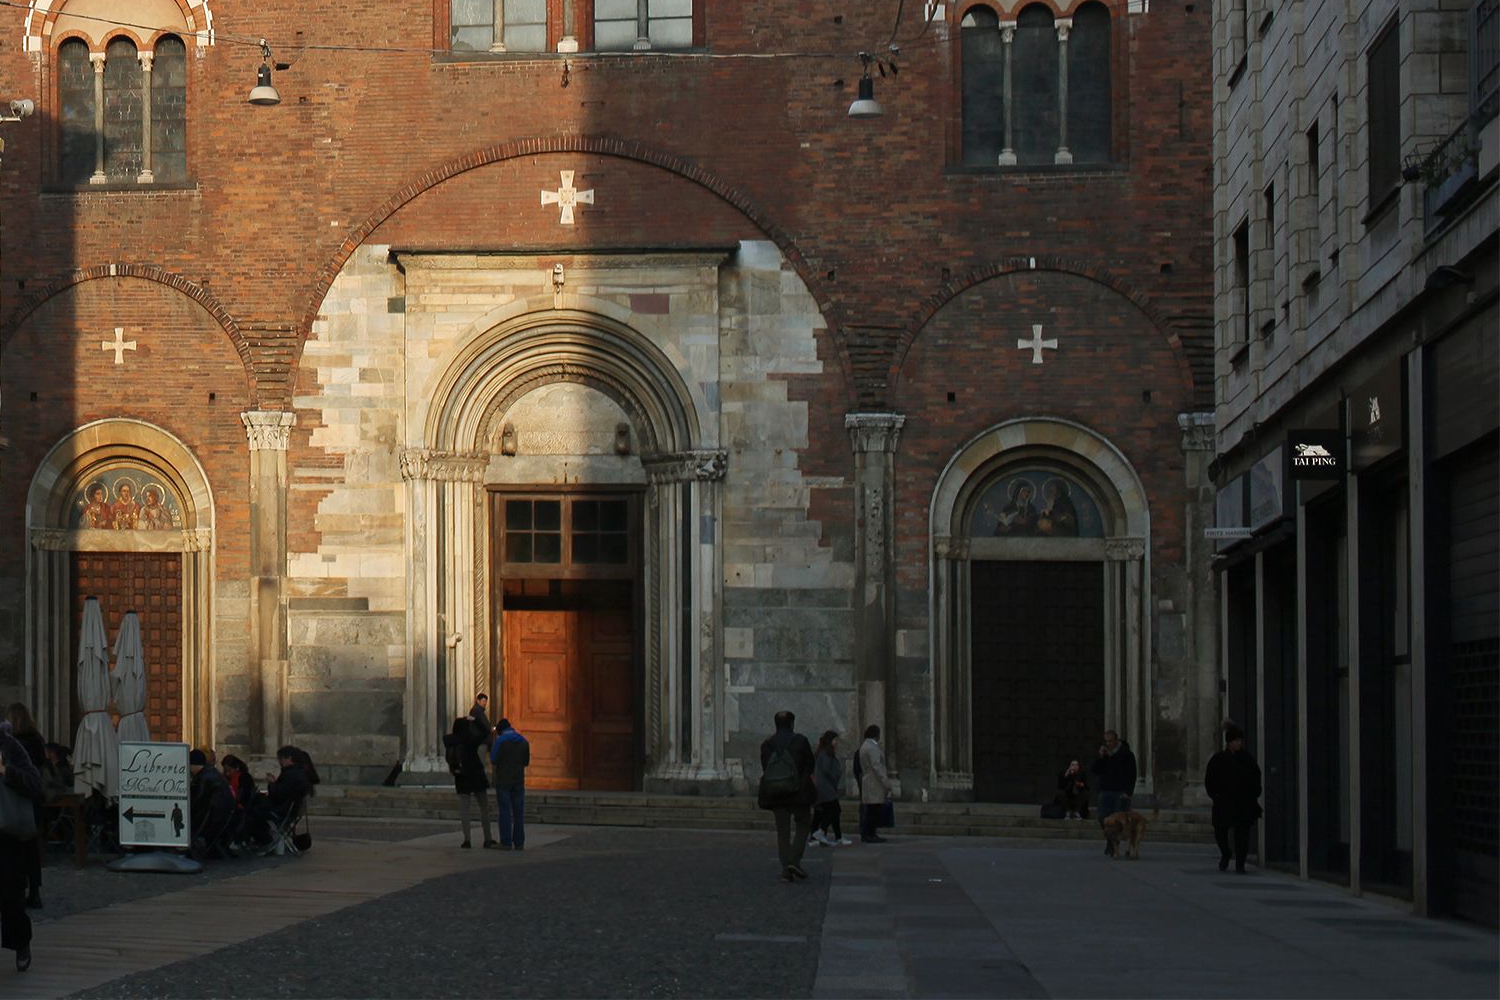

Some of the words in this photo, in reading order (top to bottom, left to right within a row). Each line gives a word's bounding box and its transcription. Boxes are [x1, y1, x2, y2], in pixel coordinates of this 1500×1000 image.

[1293, 457, 1309, 466] TAI
[1312, 457, 1336, 466] PING
[122, 749, 186, 774] Libreria
